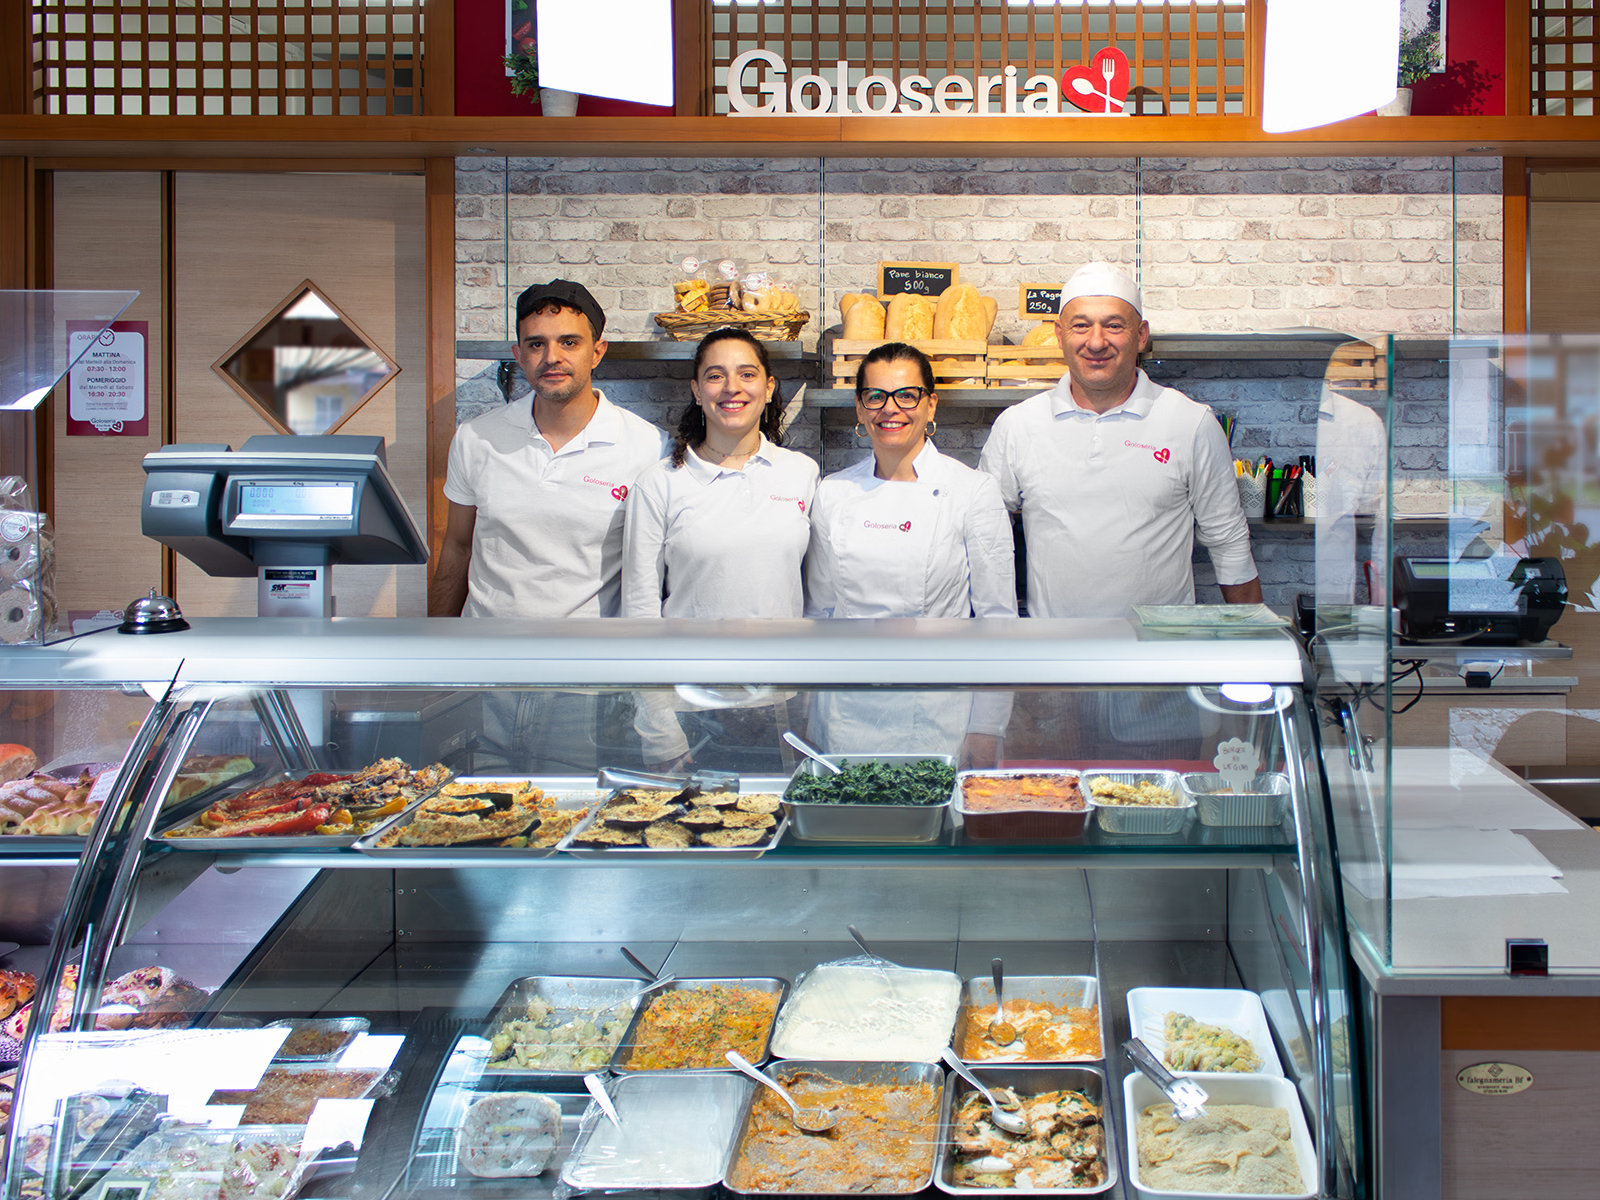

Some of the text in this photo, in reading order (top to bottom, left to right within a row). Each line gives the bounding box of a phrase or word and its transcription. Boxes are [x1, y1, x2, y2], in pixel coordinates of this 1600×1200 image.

[727, 49, 1059, 115] Goloseria
[888, 269, 944, 280] Pane bianco
[904, 280, 930, 294] 500g
[1026, 290, 1038, 299] La
[1029, 301, 1052, 314] 250g
[1124, 439, 1157, 451] Goloseria
[583, 475, 615, 488] Goloseria
[770, 494, 799, 502] Goloseria
[863, 520, 898, 530] Goloseria
